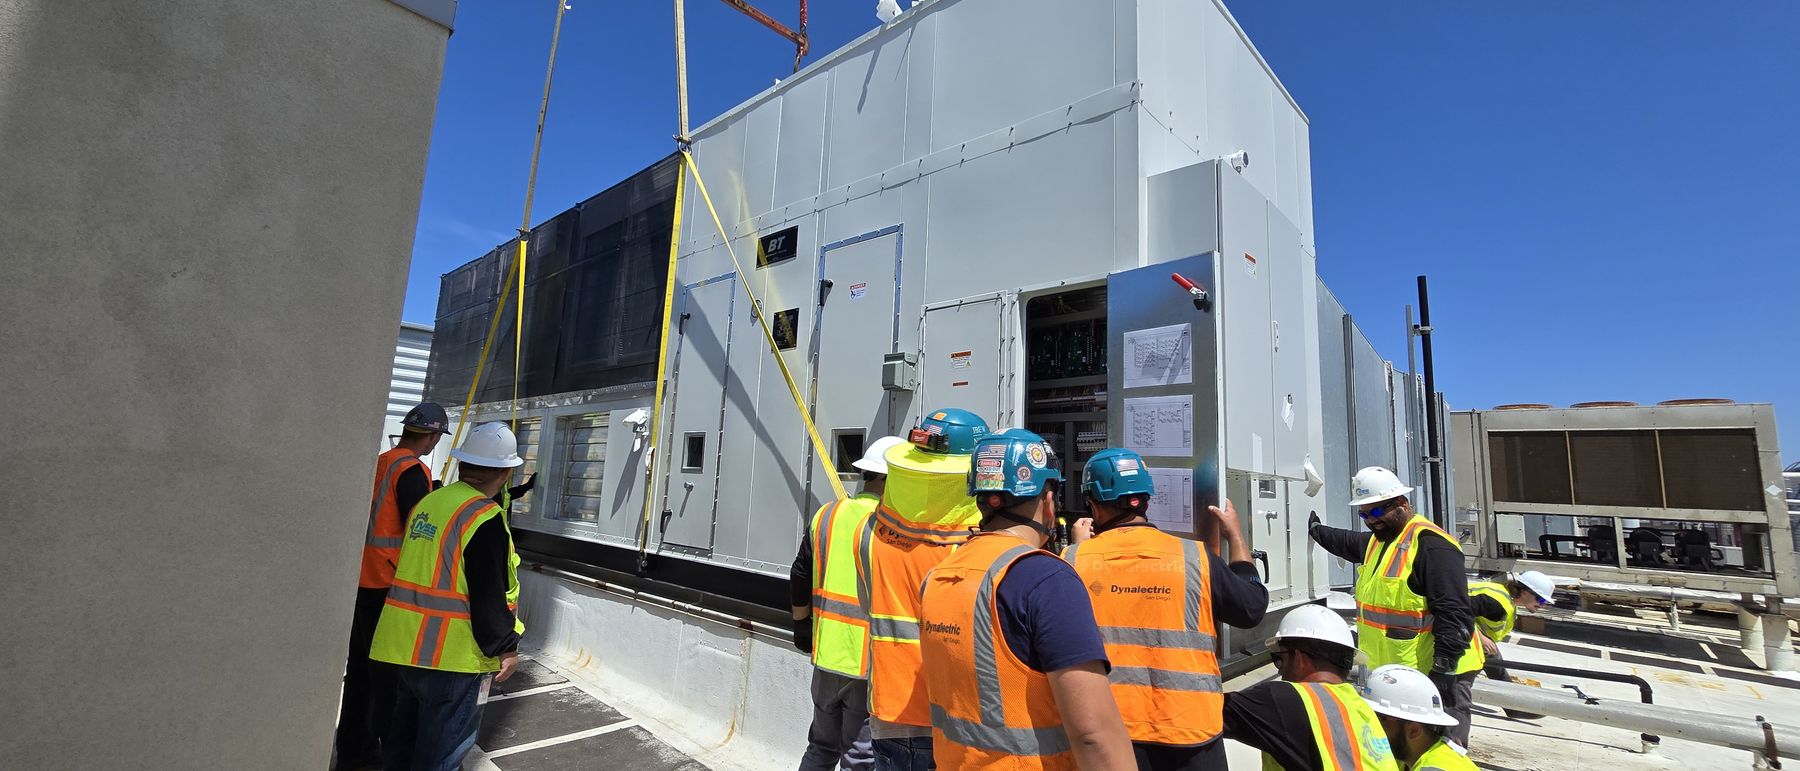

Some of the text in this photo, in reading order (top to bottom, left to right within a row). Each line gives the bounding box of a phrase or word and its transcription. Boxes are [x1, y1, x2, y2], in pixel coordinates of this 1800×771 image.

[767, 235, 786, 252] BT
[1111, 584, 1171, 595] Dynalectric
[925, 621, 961, 635] Dynalectric
